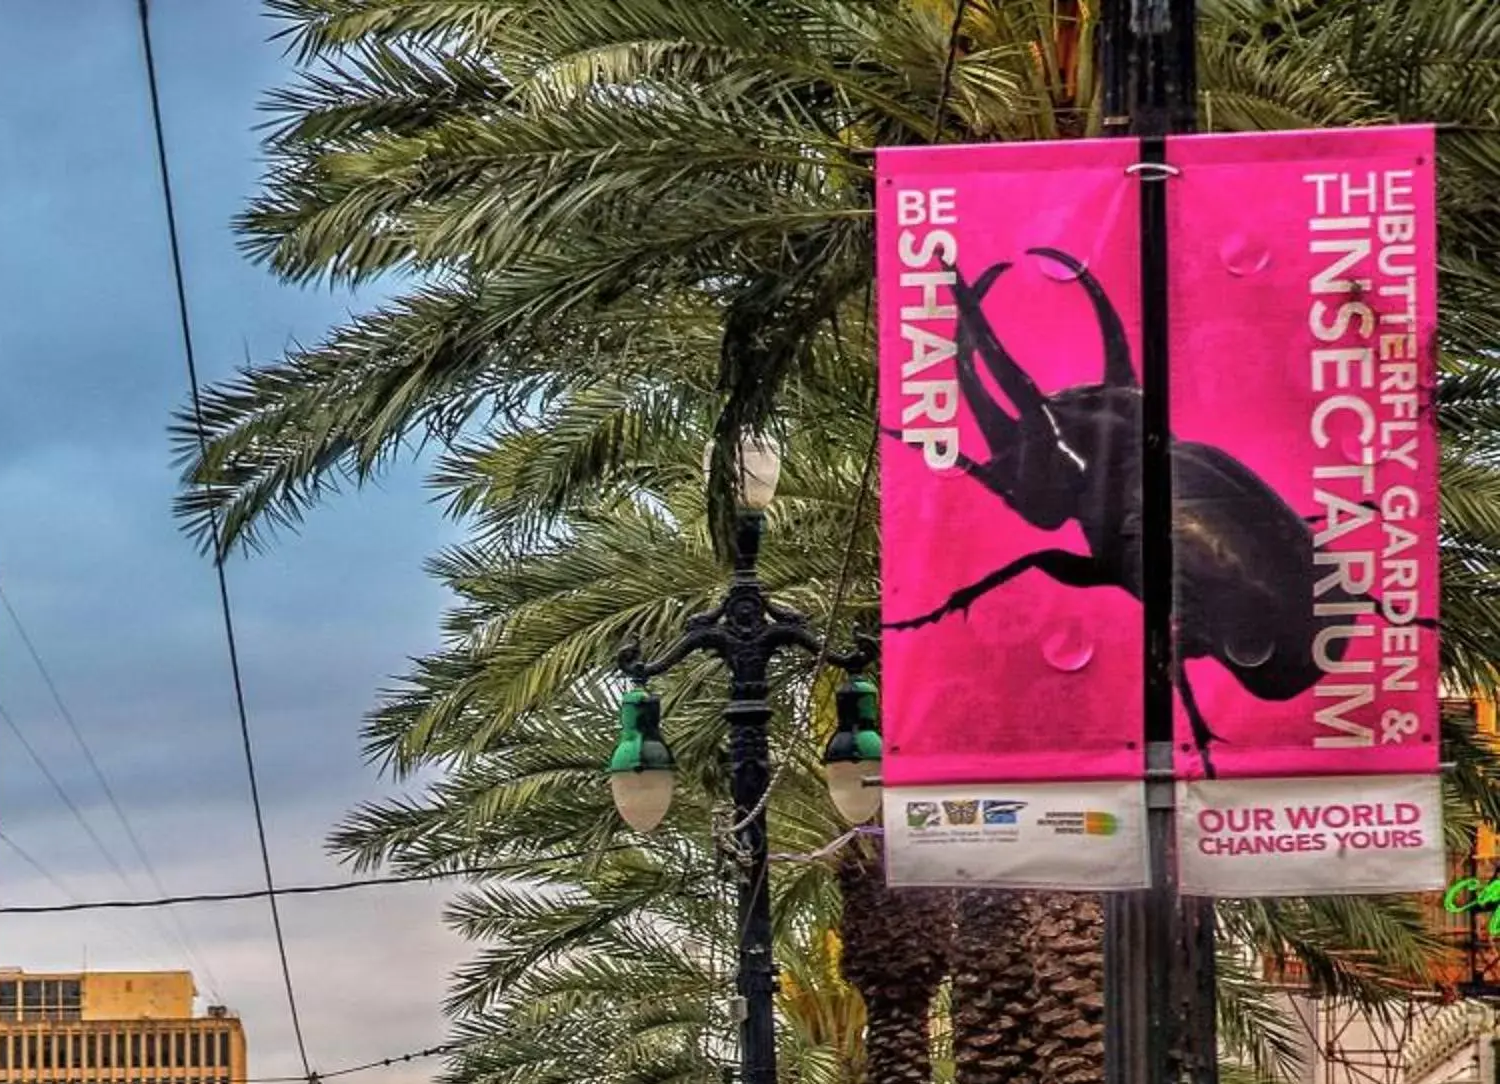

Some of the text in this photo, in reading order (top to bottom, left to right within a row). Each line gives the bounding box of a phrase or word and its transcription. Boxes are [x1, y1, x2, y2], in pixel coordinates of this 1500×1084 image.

[898, 187, 957, 226] BE
[1303, 170, 1415, 214] THE
[898, 230, 959, 471] SHARP
[1309, 217, 1378, 749] INSECTARIUM
[1378, 215, 1420, 744] BUTTERFLY GARDEN &
[1199, 803, 1421, 833] OUR WORLD
[1199, 829, 1423, 855] CHANGES YOURS
